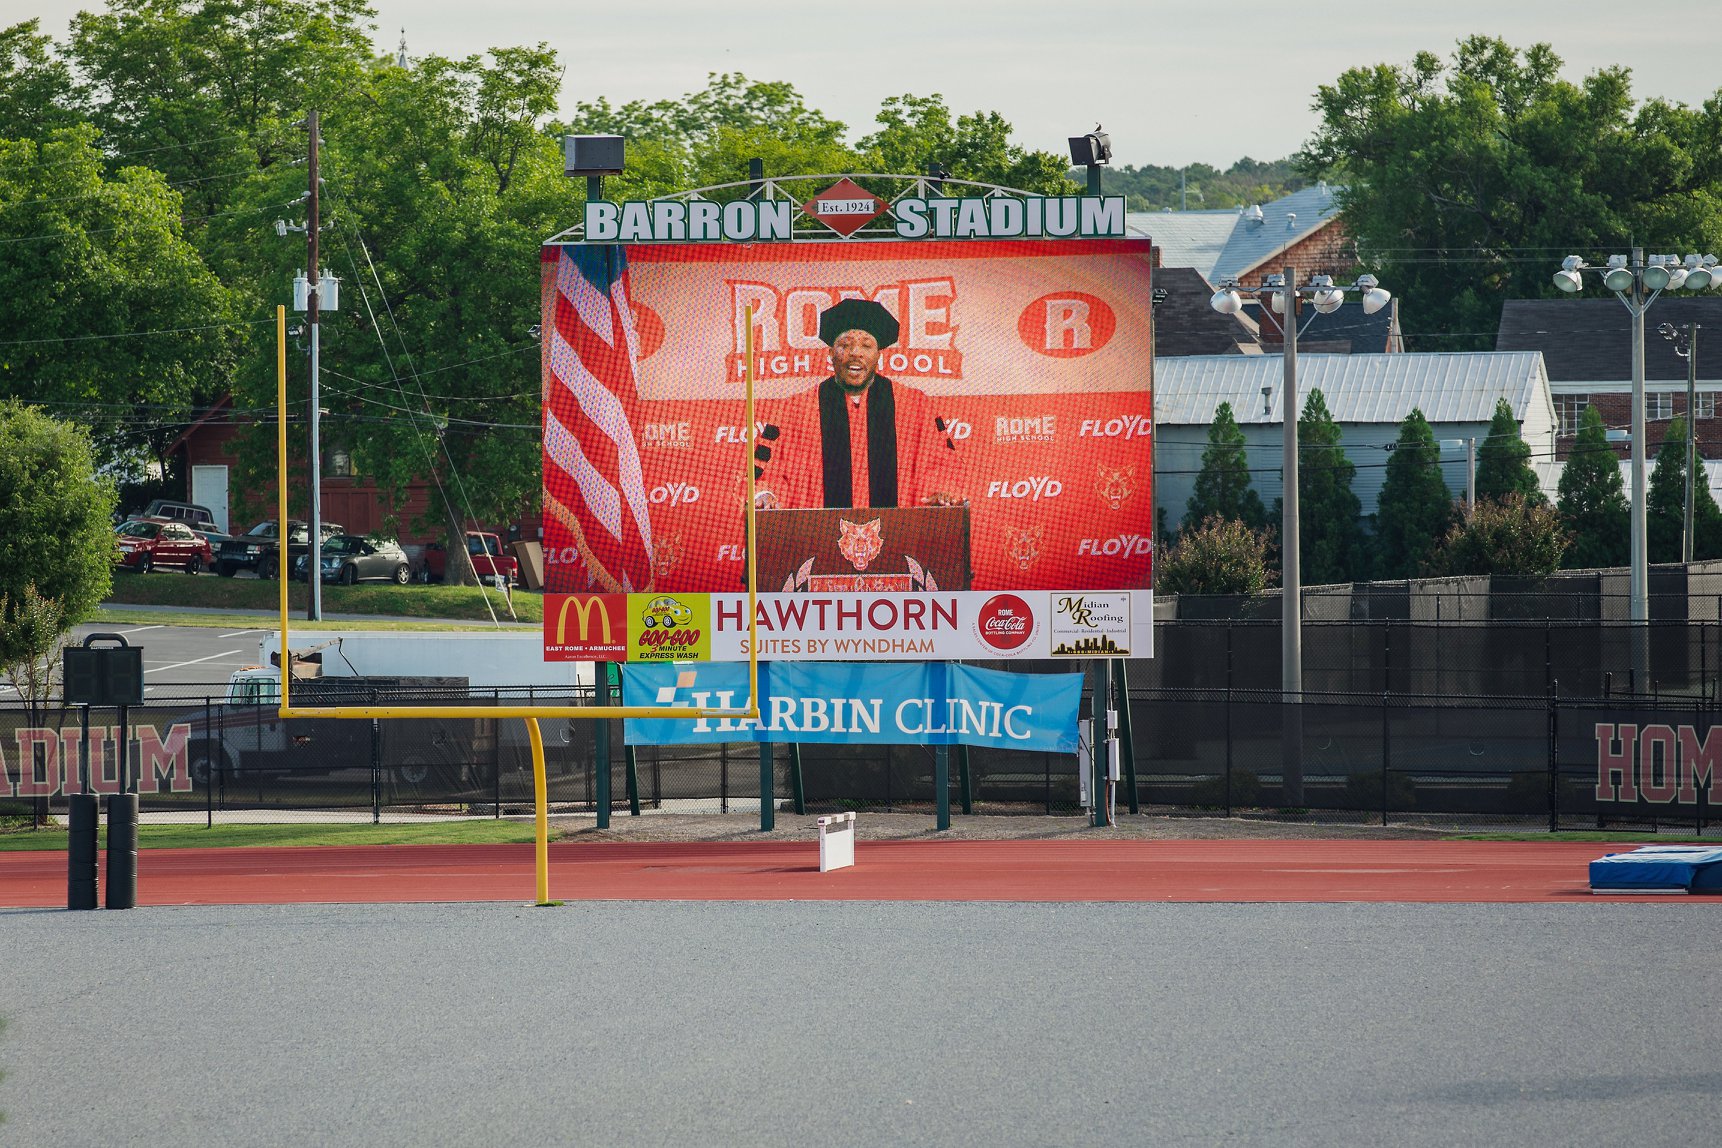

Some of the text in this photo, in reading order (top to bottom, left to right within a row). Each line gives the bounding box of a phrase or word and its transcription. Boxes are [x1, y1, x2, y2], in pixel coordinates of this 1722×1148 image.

[821, 201, 870, 213] Est. 1924
[895, 195, 1127, 239] STADIUM
[584, 200, 793, 241] BARRON
[1044, 299, 1094, 350] R
[641, 421, 692, 442] OME
[996, 416, 1056, 436] ROME
[1080, 415, 1151, 441] FLOYD
[1021, 434, 1055, 442] SCHOOL
[987, 476, 1063, 502] FLOYD
[1078, 534, 1152, 560] FLOYD
[717, 598, 958, 632] HAWTHORN
[997, 608, 1014, 617] ROME
[1057, 596, 1109, 614] Midian
[985, 616, 1028, 631] Coca-Cola
[1072, 608, 1124, 628] Roofing
[638, 629, 701, 647] GOO-GOO
[651, 643, 658, 653] 3
[740, 638, 935, 654] SUITES BY WYNDHAM
[692, 690, 1033, 740] HARBIN CLINIC
